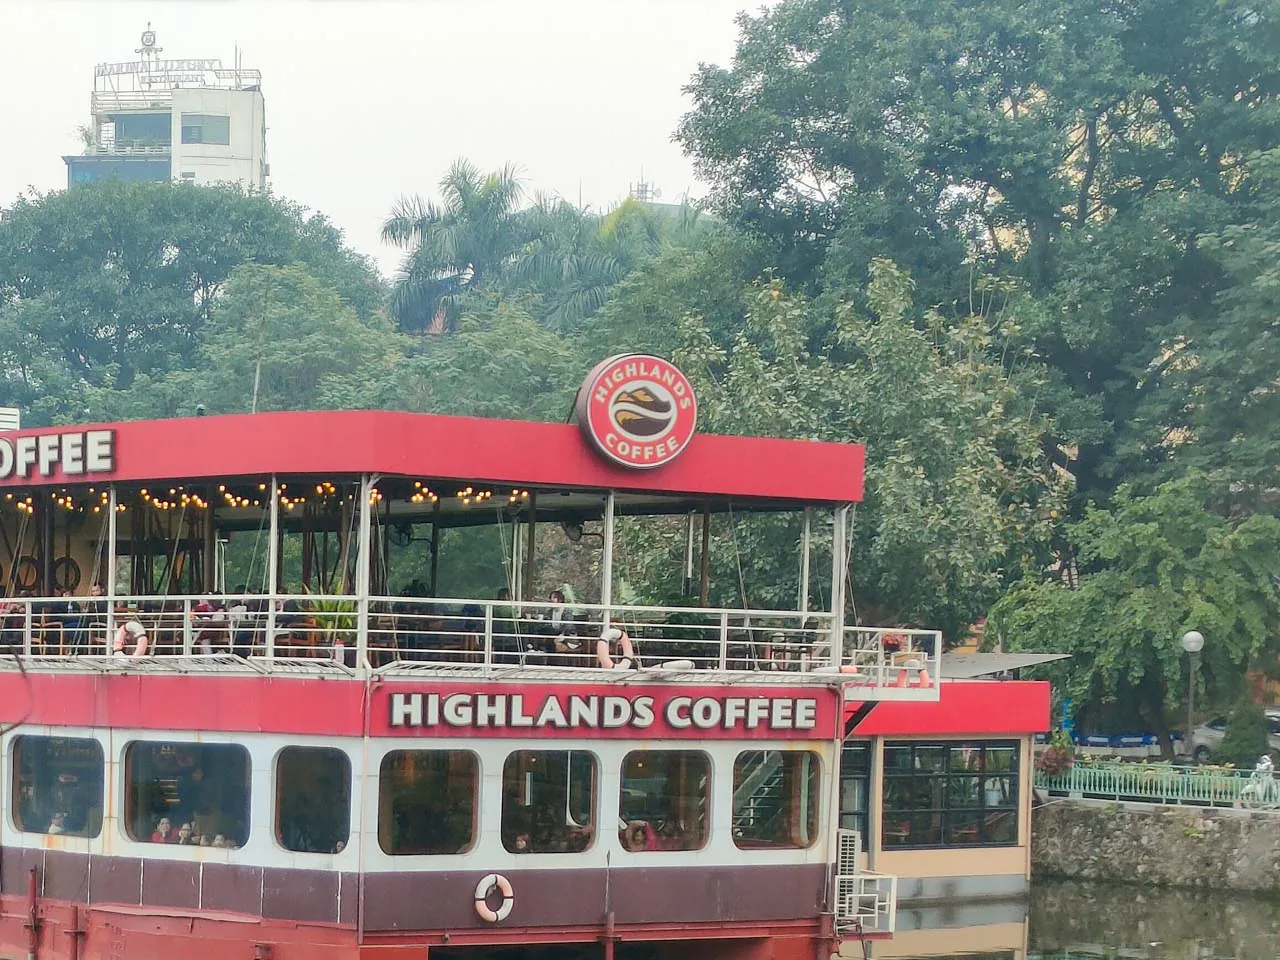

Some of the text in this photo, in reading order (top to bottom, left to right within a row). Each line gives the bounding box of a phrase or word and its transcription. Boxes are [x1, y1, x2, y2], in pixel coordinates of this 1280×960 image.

[594, 362, 692, 410] HIGHLANDS
[605, 432, 680, 460] COFFEE
[390, 692, 817, 730] HIGHLANDS COFFEE
